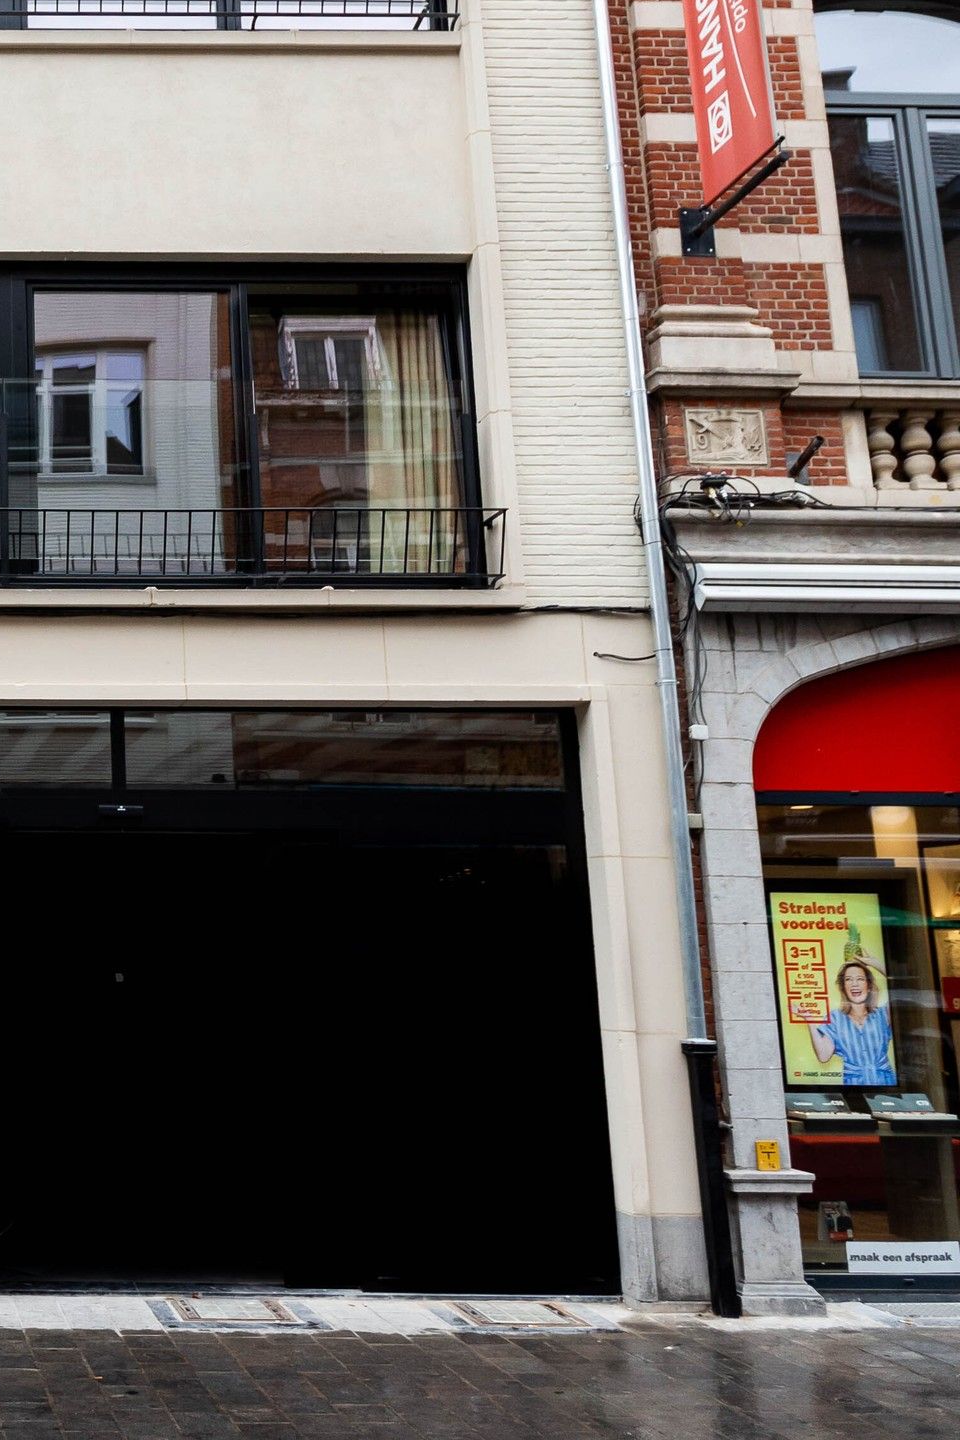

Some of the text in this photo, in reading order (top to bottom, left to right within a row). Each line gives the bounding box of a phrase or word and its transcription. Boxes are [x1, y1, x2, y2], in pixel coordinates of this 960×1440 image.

[778, 901, 846, 915] Stralend
[780, 918, 849, 930] voordeel
[790, 946, 817, 959] 3=1
[850, 1252, 953, 1263] maak een afspraak
